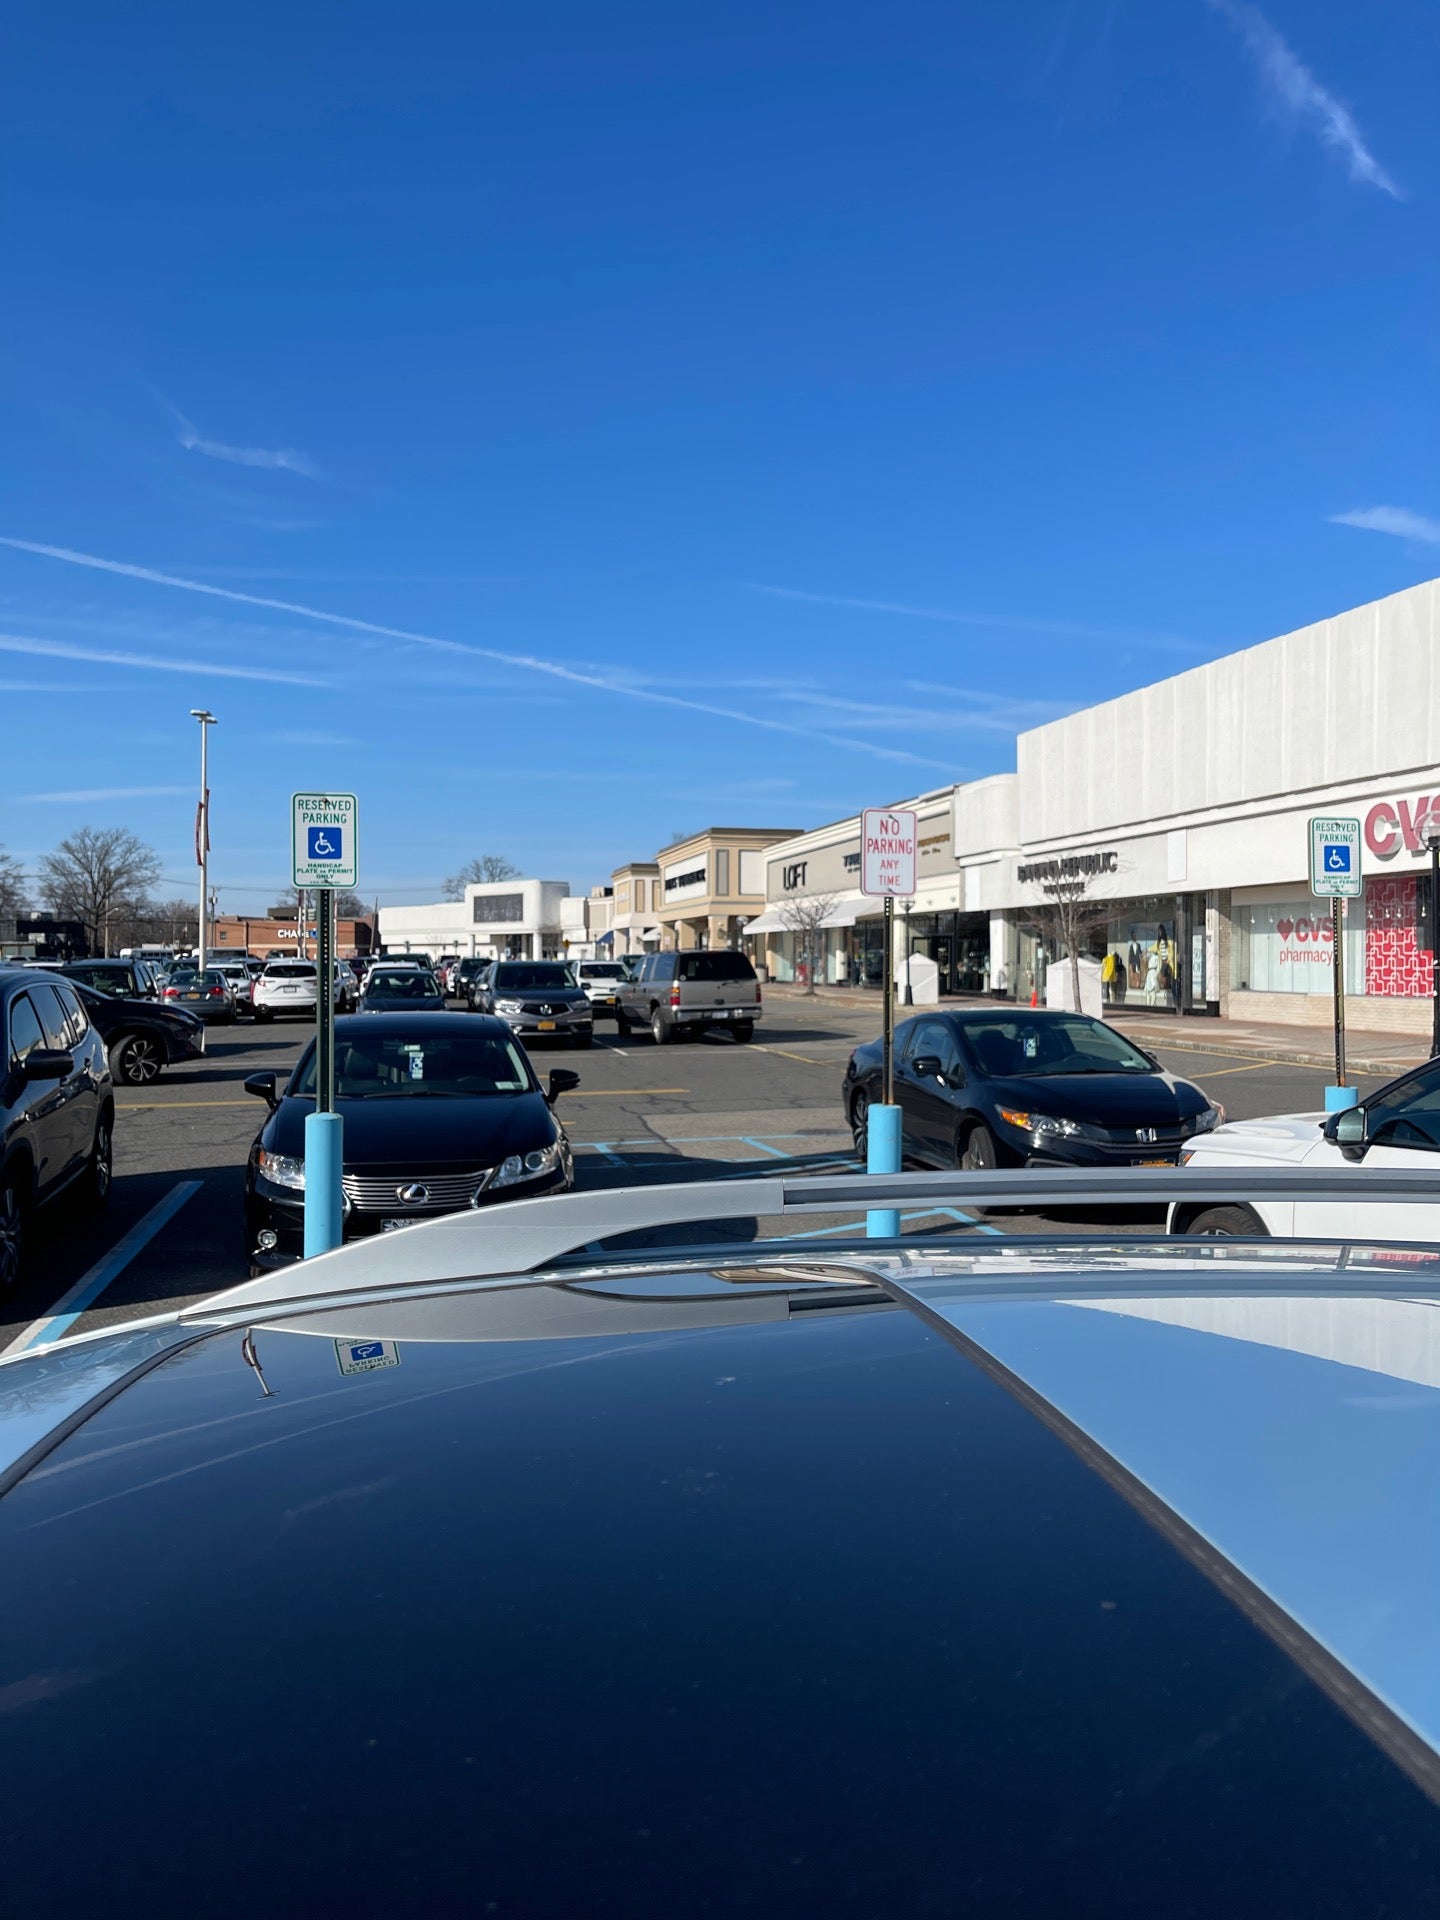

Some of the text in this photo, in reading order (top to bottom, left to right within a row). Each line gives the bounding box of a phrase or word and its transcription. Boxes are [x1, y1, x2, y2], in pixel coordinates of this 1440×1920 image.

[297, 799, 352, 811] RESERVED
[302, 813, 347, 824] PARKING
[1365, 794, 1440, 855] CV
[880, 820, 900, 835] NO
[1315, 823, 1357, 832] RESERVED
[1319, 834, 1354, 842] PARKING
[867, 838, 913, 855] PARKING
[880, 860, 900, 870] ANY
[783, 862, 808, 891] LOFT
[879, 875, 901, 886] TIME
[277, 929, 310, 939] CHAE
[1295, 917, 1333, 943] CVS
[1280, 947, 1333, 966] pharmacy
